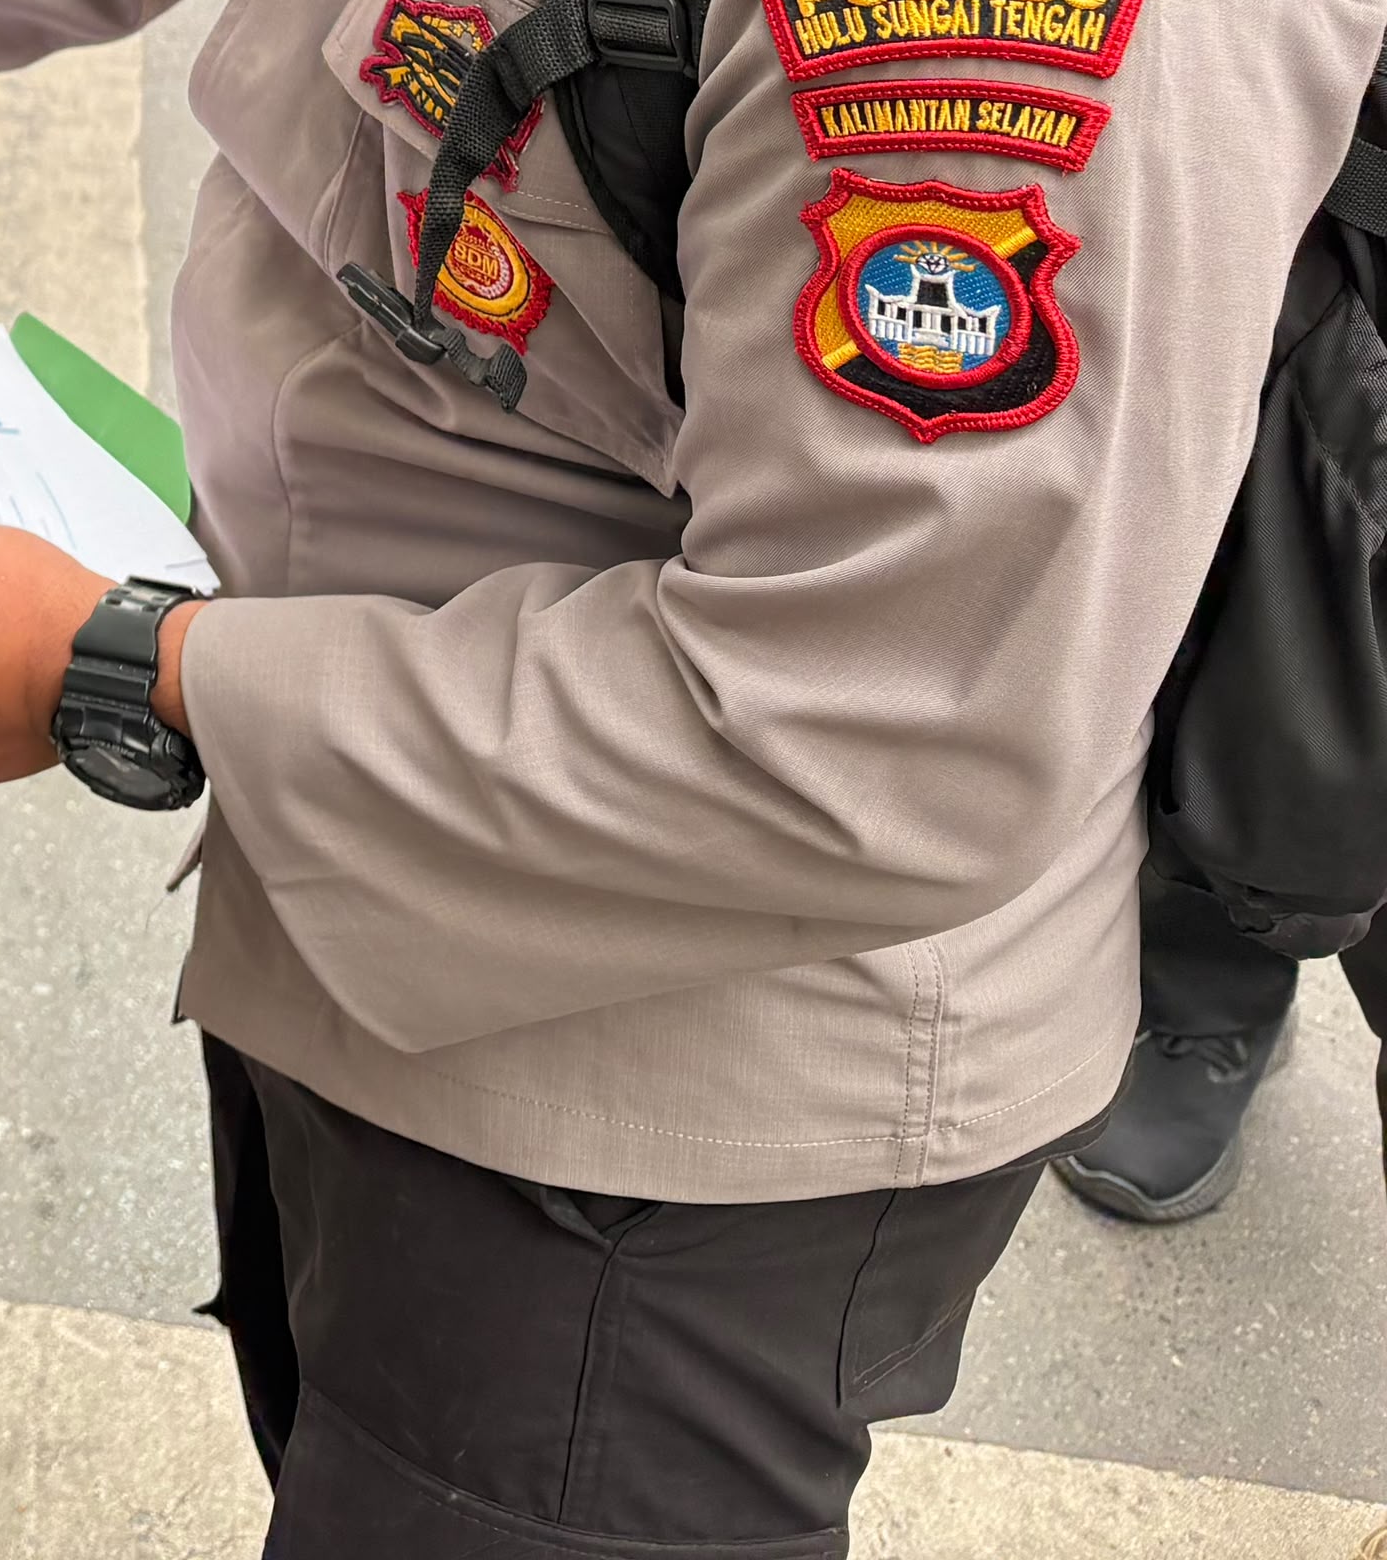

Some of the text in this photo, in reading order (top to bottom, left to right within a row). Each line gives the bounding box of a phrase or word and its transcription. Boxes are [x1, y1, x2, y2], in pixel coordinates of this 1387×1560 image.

[794, 12, 869, 56] HULU
[819, 97, 1076, 148] KALIMANTAN SELATAN
[447, 240, 505, 280] SDM
